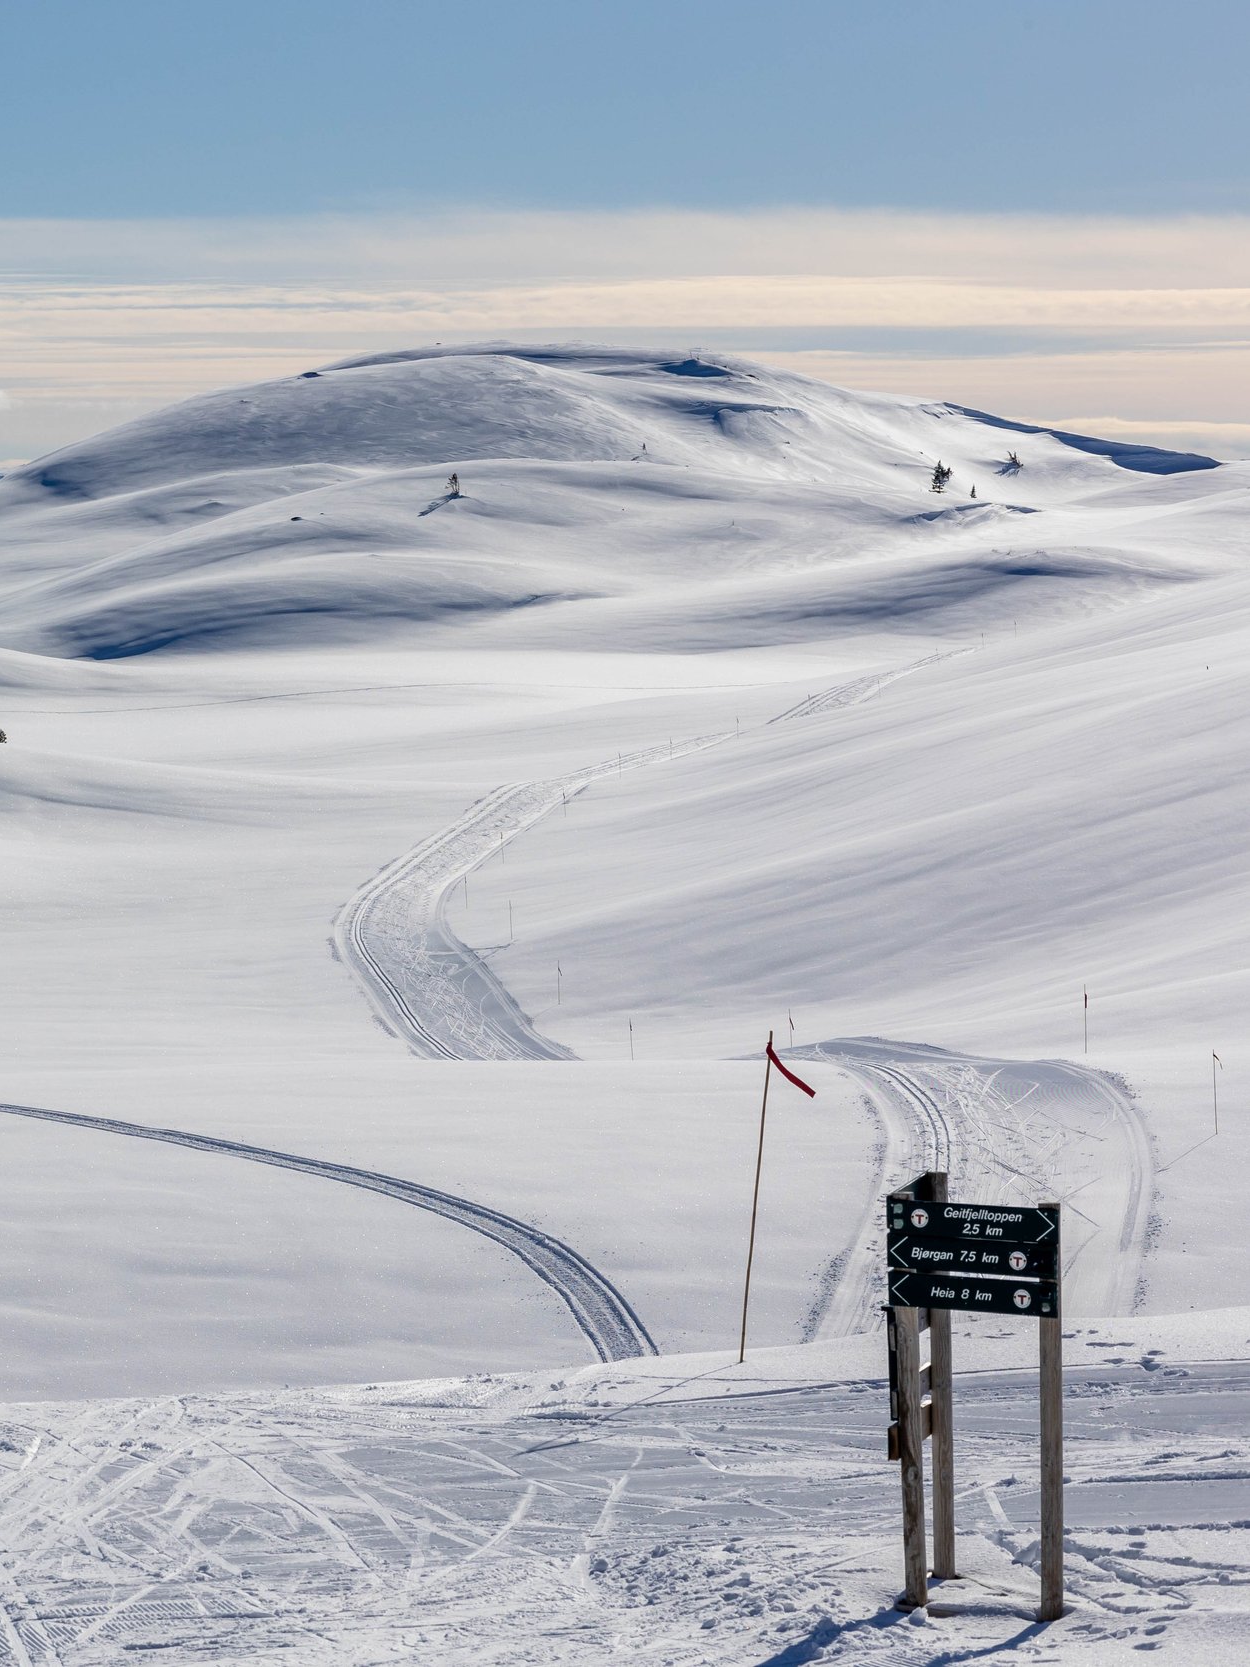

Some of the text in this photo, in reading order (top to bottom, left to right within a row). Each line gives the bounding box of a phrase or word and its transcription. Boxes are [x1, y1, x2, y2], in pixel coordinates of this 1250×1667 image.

[943, 1206, 1023, 1222] Geitfjelltoppen
[985, 1224, 1003, 1236] km
[911, 1247, 999, 1264] Bjørgan 7,5 km
[930, 1286, 992, 1301] Heia 8 km
